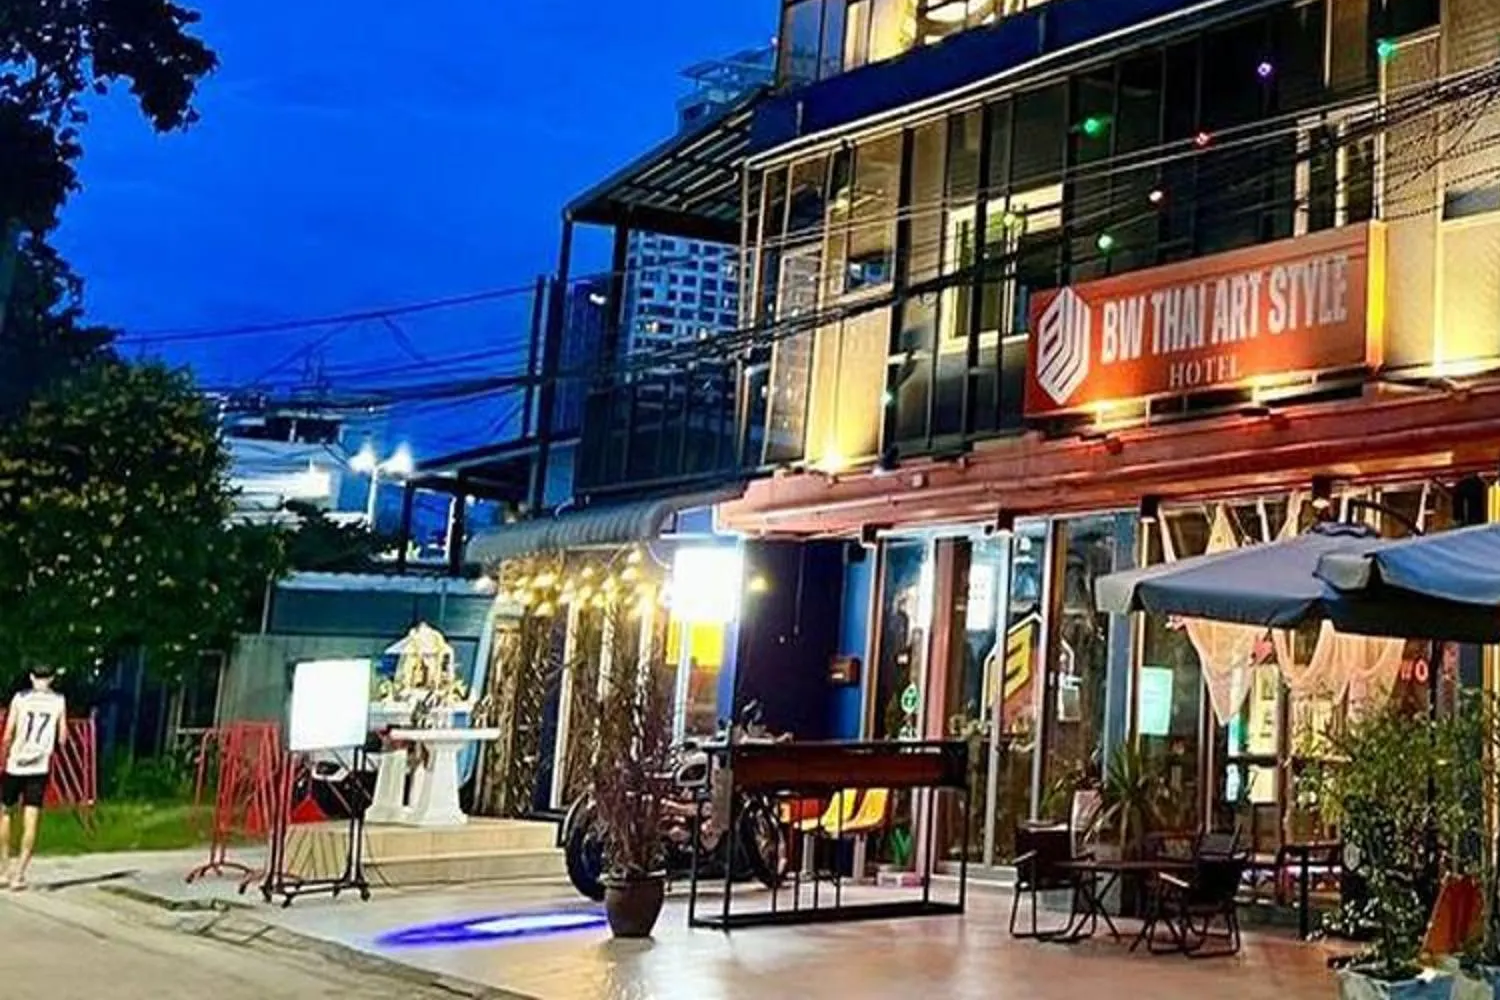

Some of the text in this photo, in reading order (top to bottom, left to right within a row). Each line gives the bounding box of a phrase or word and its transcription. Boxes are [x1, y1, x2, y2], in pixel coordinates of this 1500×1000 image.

[1101, 254, 1347, 364] BW THAI ART STYLE
[1169, 355, 1239, 387] HOTEL
[25, 711, 51, 743] 17
